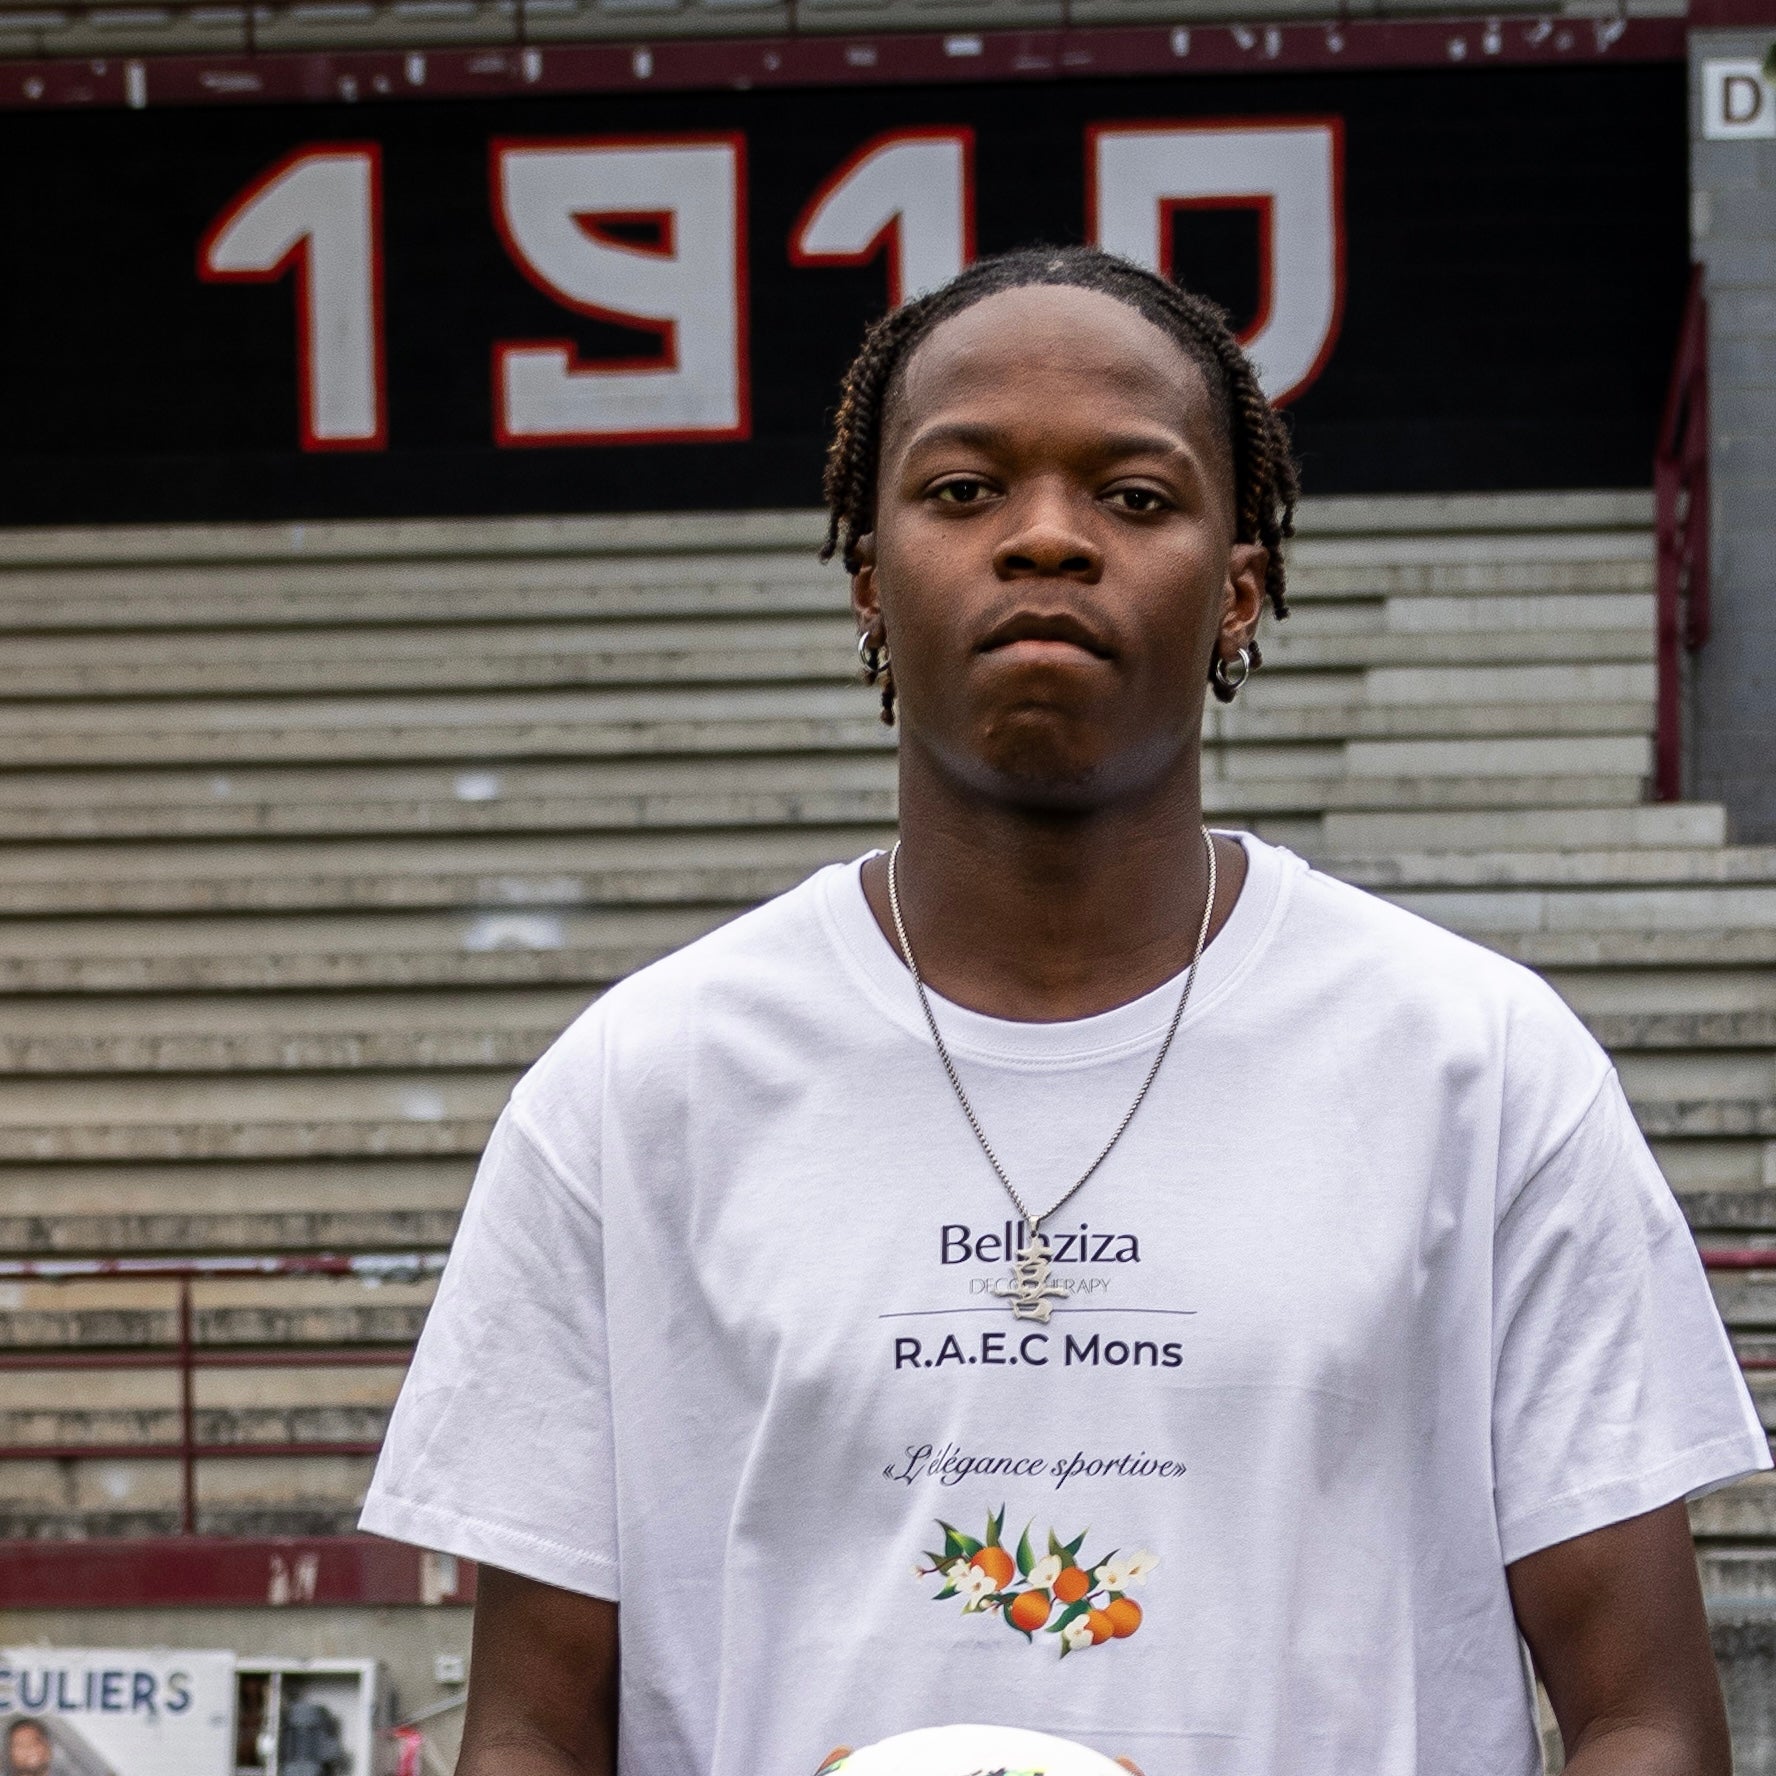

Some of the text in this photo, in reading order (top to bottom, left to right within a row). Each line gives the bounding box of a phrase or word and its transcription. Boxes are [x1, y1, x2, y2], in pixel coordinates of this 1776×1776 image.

[1723, 76, 1762, 124] D
[895, 1332, 1184, 1369] R.A.E.C Mons
[1049, 1450, 1187, 1490] sportive»
